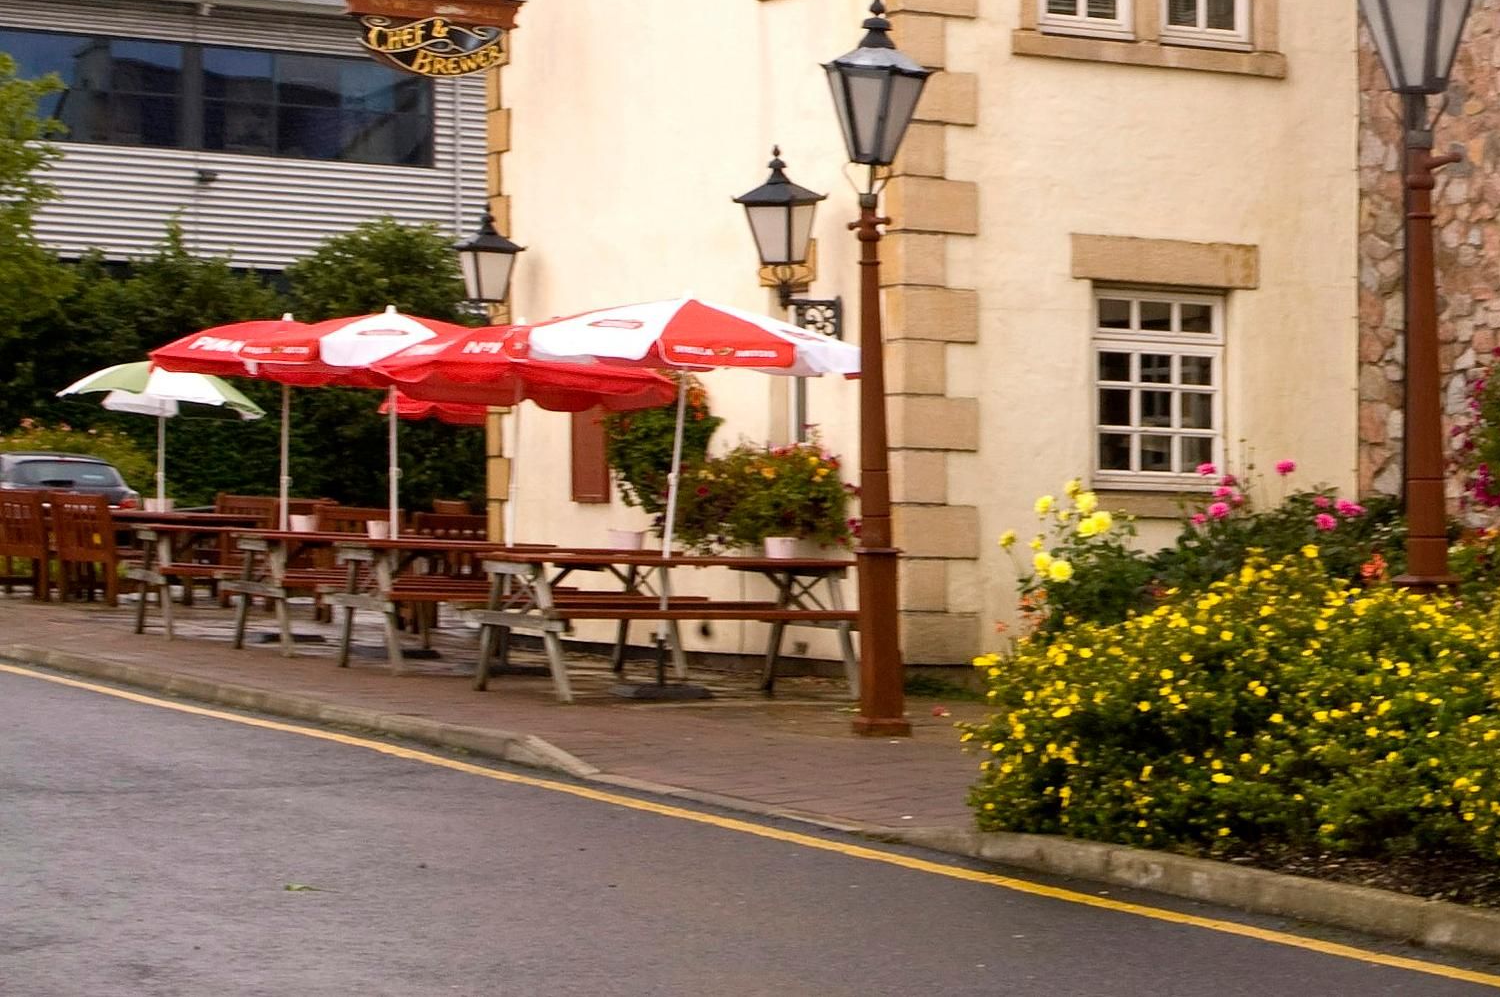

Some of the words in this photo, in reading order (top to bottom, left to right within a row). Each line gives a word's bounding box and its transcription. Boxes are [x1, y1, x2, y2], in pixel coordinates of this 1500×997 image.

[368, 22, 427, 50] CHEF
[431, 19, 449, 38] &
[410, 45, 503, 75] BREWER
